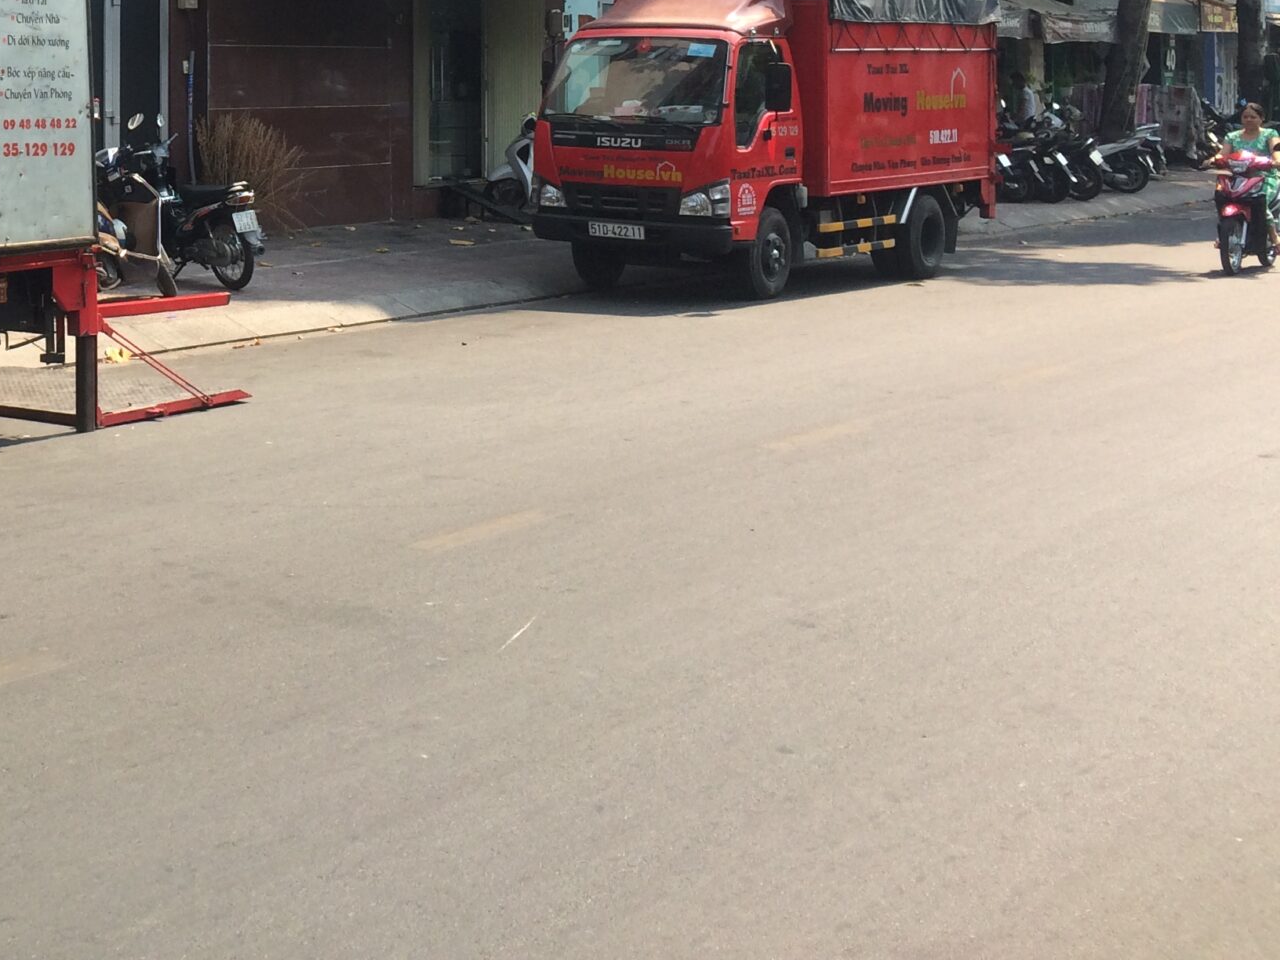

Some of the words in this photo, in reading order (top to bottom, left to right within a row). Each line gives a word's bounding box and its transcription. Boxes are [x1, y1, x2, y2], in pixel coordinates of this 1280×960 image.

[863, 91, 908, 117] Moving
[3, 119, 16, 130] 09
[19, 119, 31, 129] 48
[34, 119, 47, 129] 48
[50, 118, 62, 128] 48
[65, 118, 77, 128] 22
[53, 142, 75, 156] 129
[596, 137, 642, 147] ISUZU
[603, 164, 682, 182] House.vn
